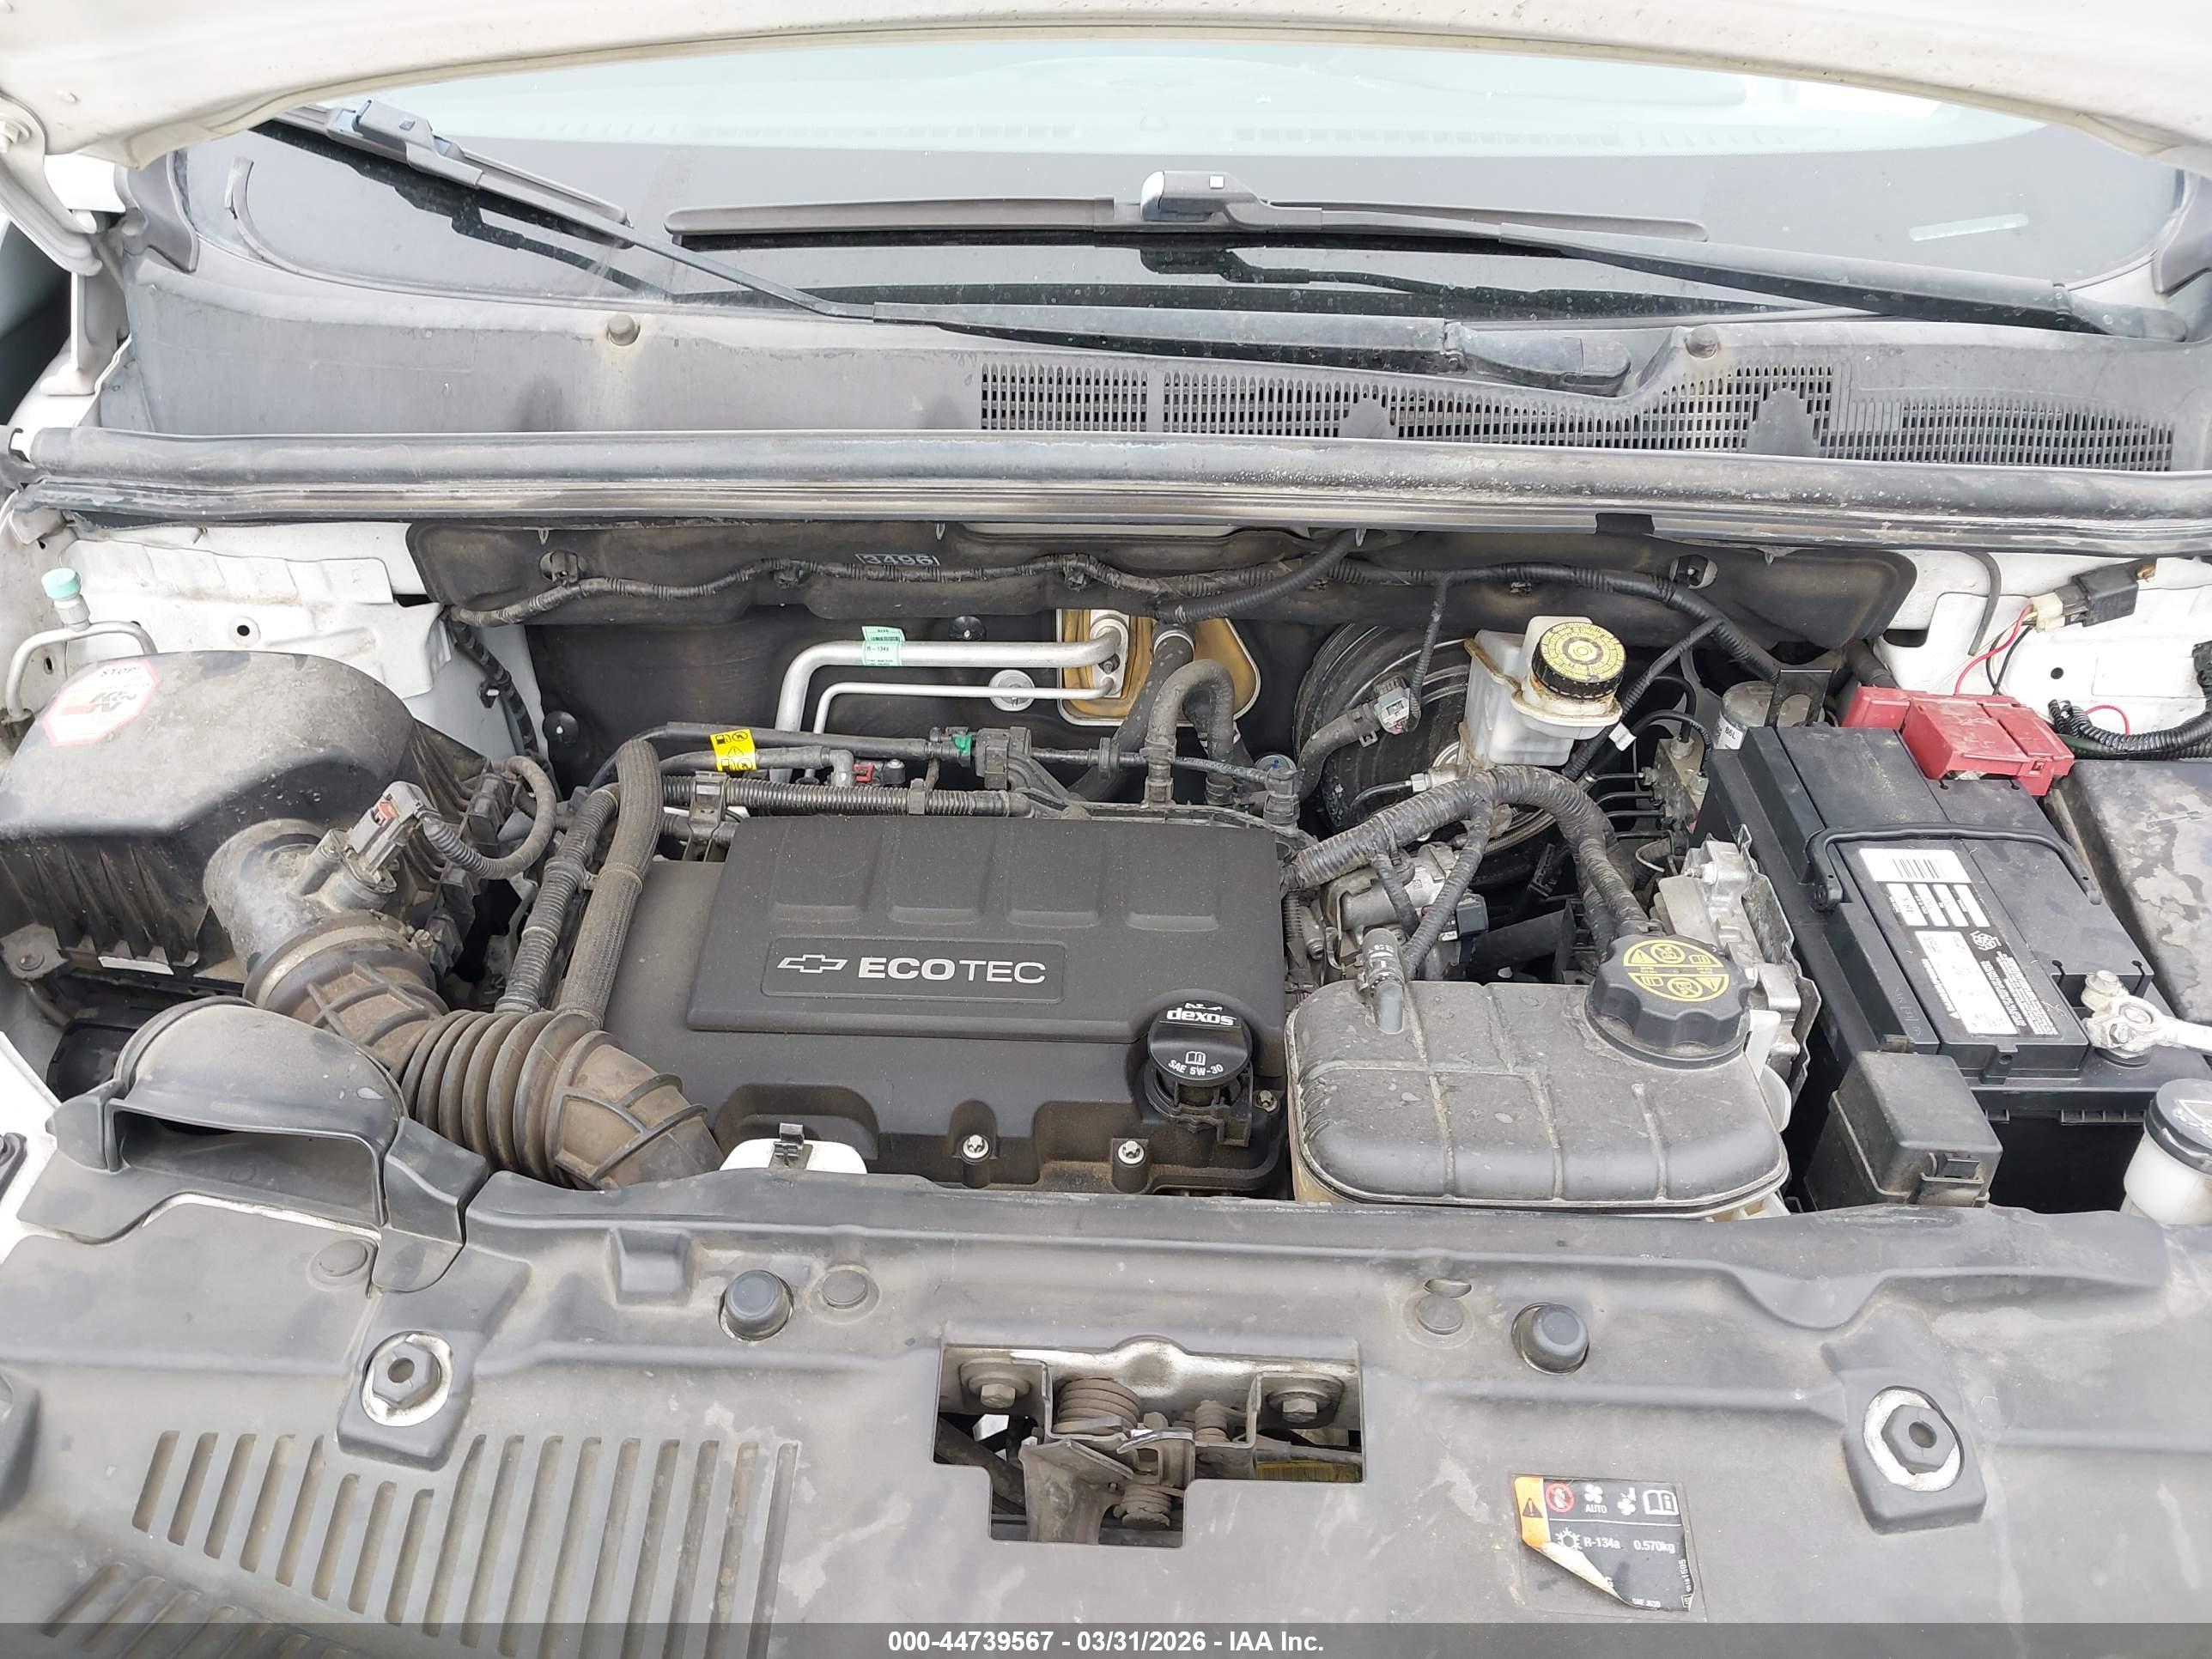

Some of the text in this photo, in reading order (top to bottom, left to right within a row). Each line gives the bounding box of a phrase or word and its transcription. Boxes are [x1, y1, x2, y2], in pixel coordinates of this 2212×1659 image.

[862, 555, 934, 565] 3496
[858, 957, 1047, 984] ECOTEC
[1166, 1007, 1237, 1026] dexos
[1168, 1059, 1224, 1076] SAE 5W-30
[1585, 1504, 1607, 1514] AUTO
[1583, 1536, 1676, 1554] R-134a 0.570kg
